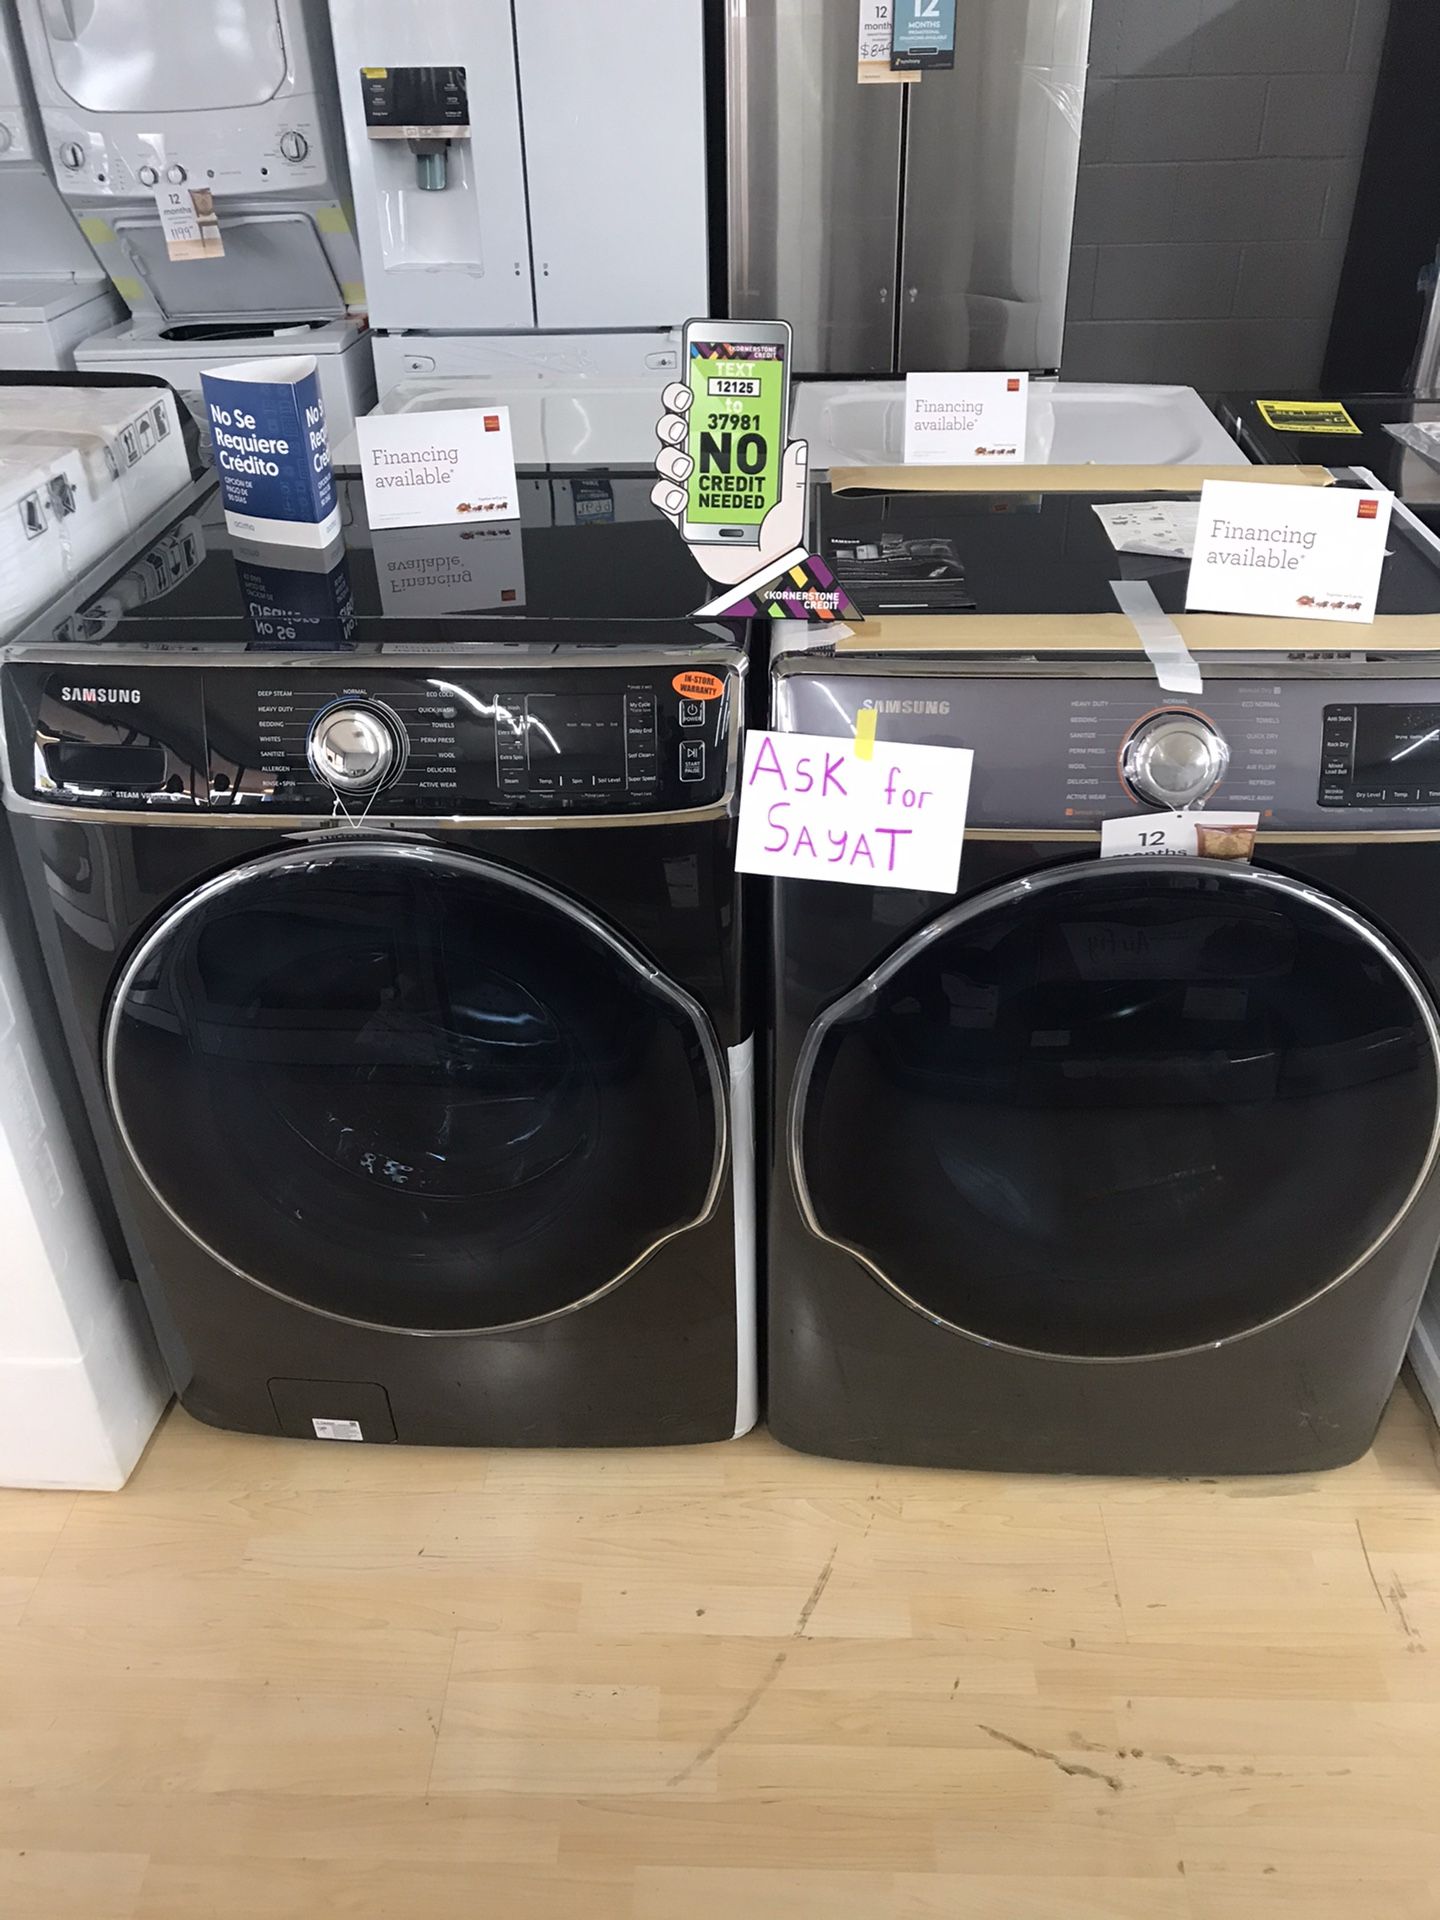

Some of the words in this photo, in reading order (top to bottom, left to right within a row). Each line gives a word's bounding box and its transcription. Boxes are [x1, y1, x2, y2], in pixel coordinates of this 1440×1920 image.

[875, 6, 887, 18] 12
[914, 0, 940, 17] 12
[864, 22, 892, 30] month
[908, 21, 941, 29] MONTHS
[168, 193, 181, 204] 12
[164, 207, 192, 215] months
[716, 363, 756, 376] TEXT
[717, 381, 754, 393] 12125
[725, 398, 743, 413] to
[915, 400, 984, 416] Financing
[211, 404, 232, 426] No
[233, 409, 256, 430] Se
[306, 406, 320, 428] No
[708, 414, 760, 430] 37981
[215, 427, 290, 455] Requiere
[372, 446, 459, 466] Financing
[700, 432, 767, 475] NO
[220, 450, 279, 477] Crédito
[699, 475, 766, 492] CREDIT
[699, 494, 765, 509] NEEDED
[1211, 519, 1318, 550] Financing
[804, 600, 840, 609] CREDIT
[684, 674, 715, 686] IN-STORE
[61, 686, 141, 704] SAMSUNG
[680, 683, 717, 695] WARRANTY
[862, 699, 951, 716] SAMSUNG
[116, 791, 140, 799] STEAM
[884, 766, 934, 809] for
[1138, 830, 1166, 847] 12
